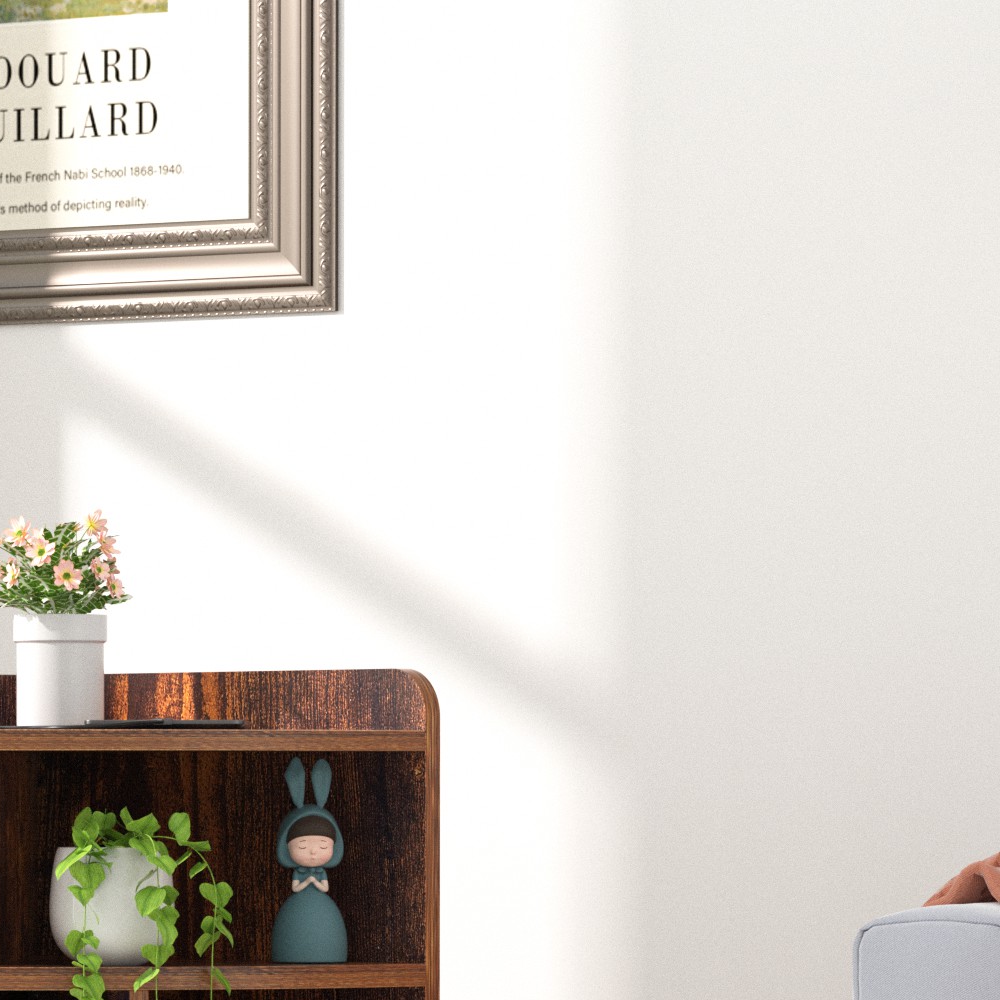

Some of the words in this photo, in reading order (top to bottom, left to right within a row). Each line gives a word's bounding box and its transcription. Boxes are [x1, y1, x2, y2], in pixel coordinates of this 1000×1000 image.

[6, 173, 22, 184] the
[26, 170, 61, 183] French
[64, 169, 88, 181] Nabi
[92, 167, 127, 179] School
[9, 202, 48, 213] method
[51, 200, 60, 212] of
[63, 198, 111, 212] depicting
